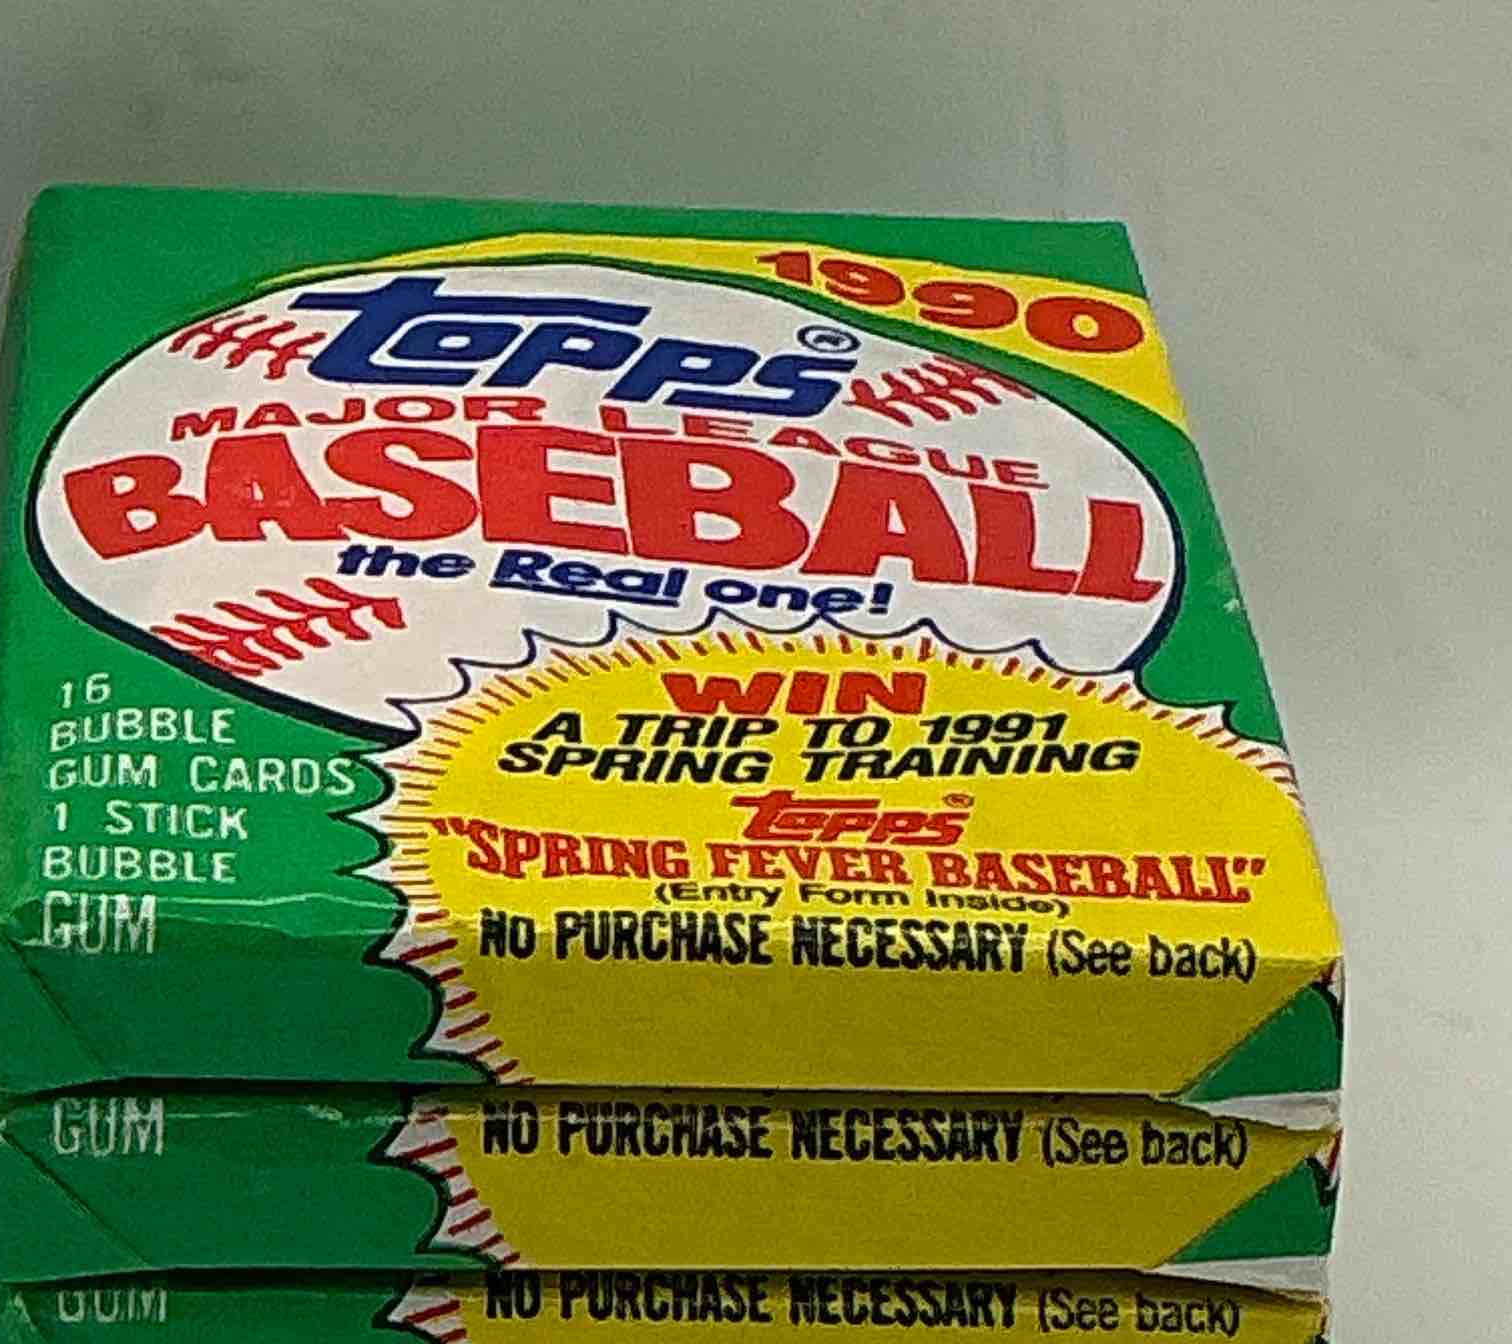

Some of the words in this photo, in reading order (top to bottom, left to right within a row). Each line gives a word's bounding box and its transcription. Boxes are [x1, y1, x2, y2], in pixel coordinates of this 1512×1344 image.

[757, 250, 1148, 353] 1990
[170, 396, 546, 442] MAJOR
[600, 405, 1049, 489] LEAGUE
[64, 425, 1164, 603] BASEBALL
[337, 544, 474, 577] the
[489, 548, 688, 607] Real
[703, 578, 893, 615] one!
[60, 673, 112, 709] 16
[660, 673, 928, 714] WIN
[49, 707, 236, 752] BUBBLE
[532, 712, 580, 744] A
[618, 714, 778, 745] TRIP
[804, 716, 886, 748] TO
[924, 712, 1068, 742] 1991
[48, 754, 159, 791] GUM
[189, 755, 356, 796] CARDS
[497, 742, 771, 783] SPRING
[800, 739, 1141, 780] TRAINING
[55, 801, 68, 832] 1
[105, 799, 249, 840] STICK
[42, 844, 238, 883] BUBBLE
[432, 817, 688, 878] "SPRING
[710, 844, 911, 885] FEVER
[931, 855, 1267, 903] BASEBALL"
[42, 889, 157, 955] GUM
[654, 880, 781, 908] (Entry
[798, 882, 910, 908] Form
[924, 890, 1072, 920] Inside)
[479, 908, 536, 960] NO
[554, 912, 774, 966] PURCHASE
[792, 916, 1028, 974] NECESSARY
[1046, 932, 1140, 981] (See
[1150, 936, 1258, 984] back)
[53, 1096, 165, 1156] GUM
[484, 1101, 539, 1157] NO
[558, 1102, 774, 1161] PURCHASE
[791, 1109, 1024, 1164] NECESSARY
[1042, 1118, 1128, 1166] (See
[1140, 1122, 1250, 1169] back)
[487, 1273, 541, 1320] NO
[560, 1274, 774, 1324] PURCHASE
[789, 1278, 1018, 1329] NECESSARY
[1038, 1291, 1122, 1334] (See
[1136, 1296, 1241, 1338] back)
